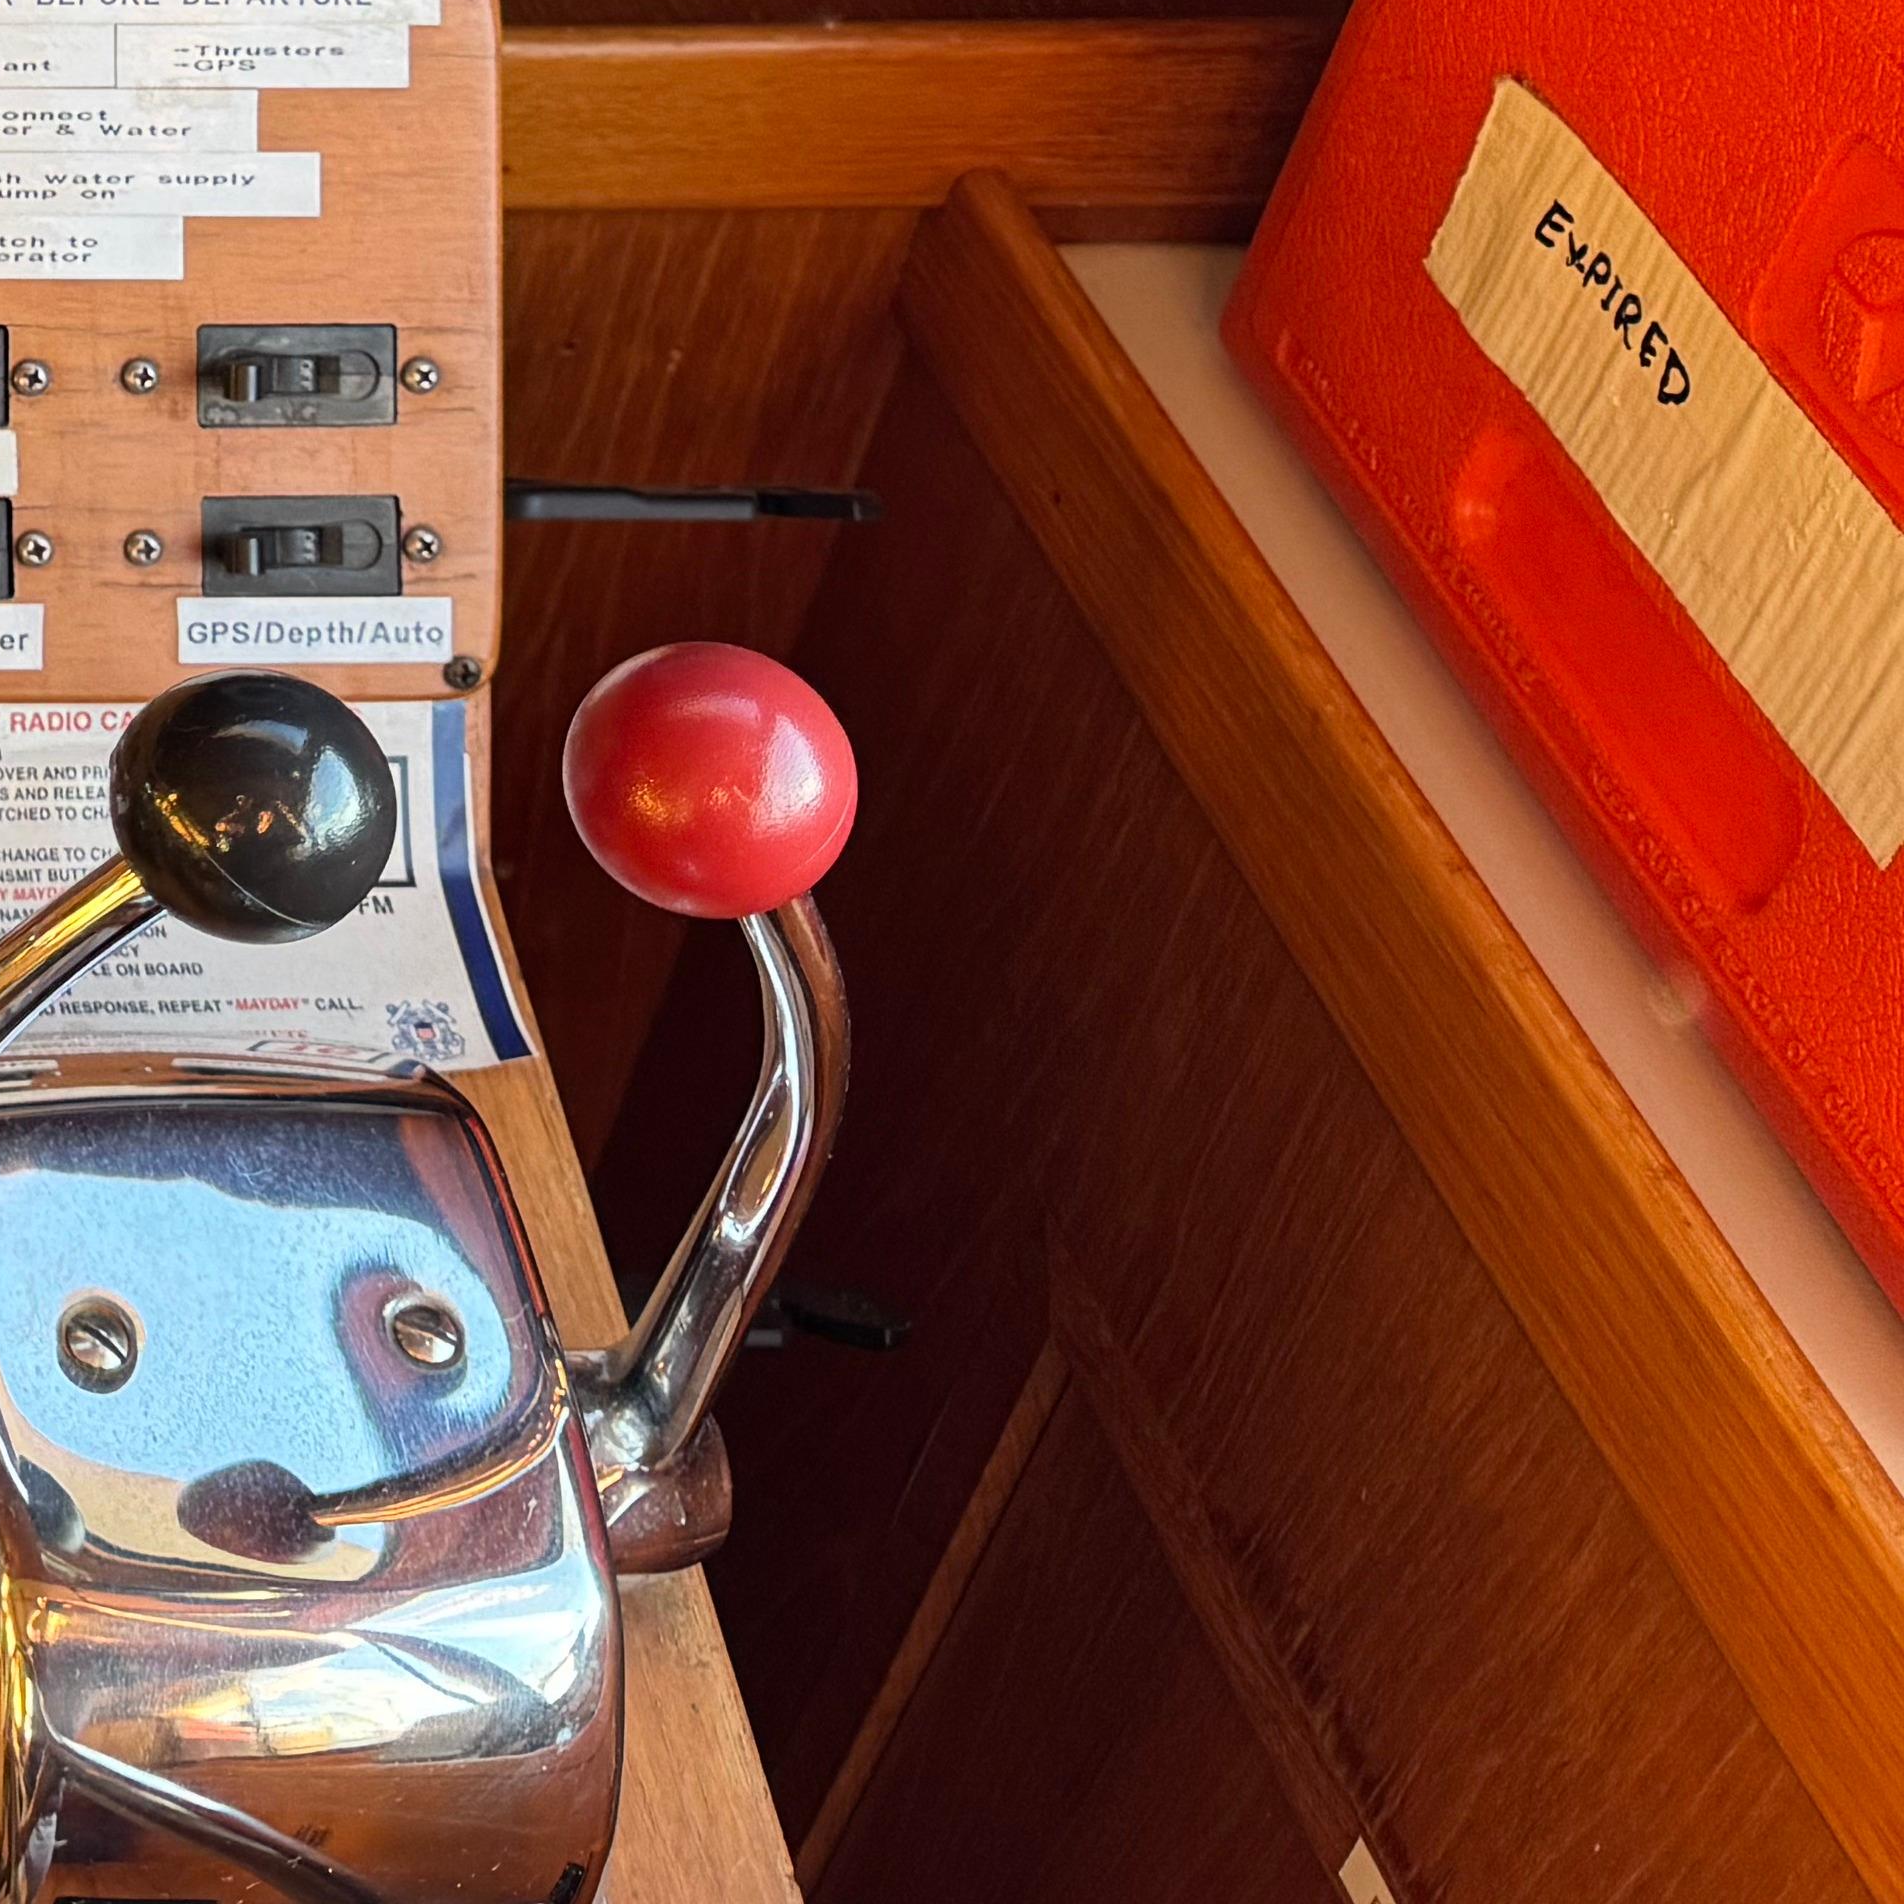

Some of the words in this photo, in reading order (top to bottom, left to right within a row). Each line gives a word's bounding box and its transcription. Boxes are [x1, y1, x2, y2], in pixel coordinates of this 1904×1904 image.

[193, 45, 344, 57] Thrusters
[193, 59, 256, 72] GPS
[56, 124, 75, 136] &
[100, 124, 192, 137] Water
[158, 174, 256, 186] supply
[80, 189, 116, 200] on
[68, 236, 98, 248] to
[1534, 199, 1691, 405] EXPIRED
[187, 618, 445, 649] GPS/Depth/Auto
[9, 711, 92, 733] RADIO
